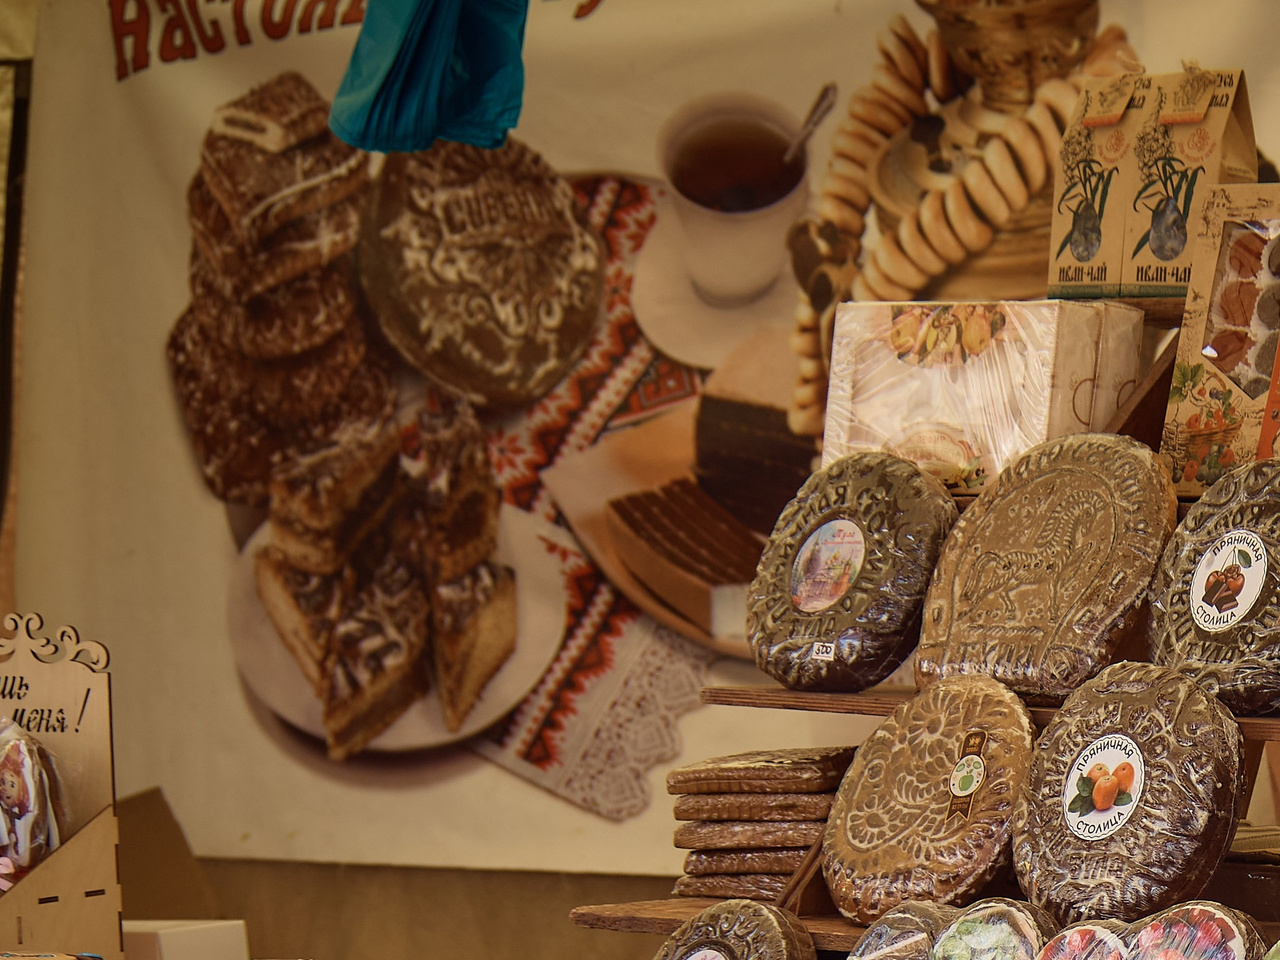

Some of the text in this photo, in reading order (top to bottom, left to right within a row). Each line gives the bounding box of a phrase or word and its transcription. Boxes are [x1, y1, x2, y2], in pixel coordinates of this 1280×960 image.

[1212, 534, 1263, 563] ПРЯНИЧНАЯ
[1196, 605, 1236, 626] СТОЛИЦА
[1076, 740, 1134, 772] ПРЯНИЧНАЯ
[1076, 810, 1125, 834] СТОЛИЦА
